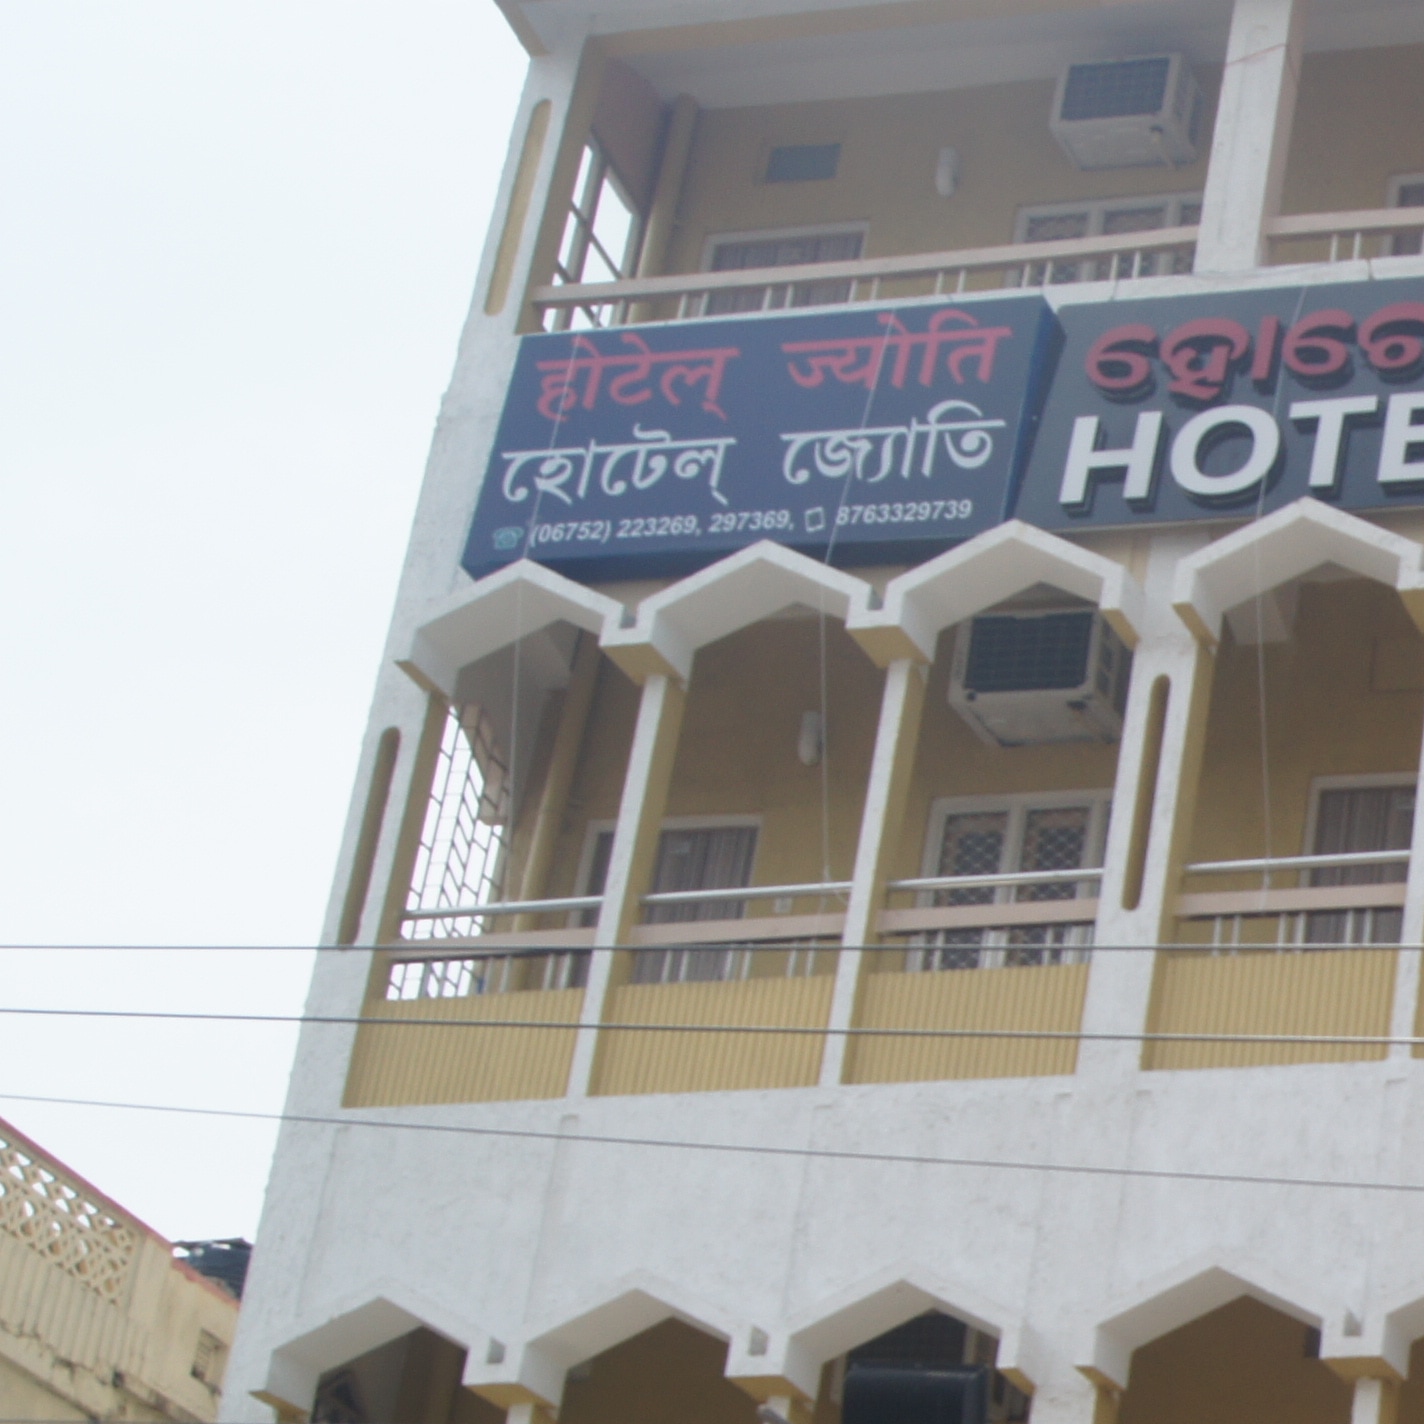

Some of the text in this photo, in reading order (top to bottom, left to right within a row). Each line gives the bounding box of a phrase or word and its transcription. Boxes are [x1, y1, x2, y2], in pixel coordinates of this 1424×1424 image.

[781, 308, 1013, 390] ज्योति
[779, 399, 1006, 484] জ্যোতি
[529, 499, 973, 546] (06752) 223269, 297369, 8763329739
